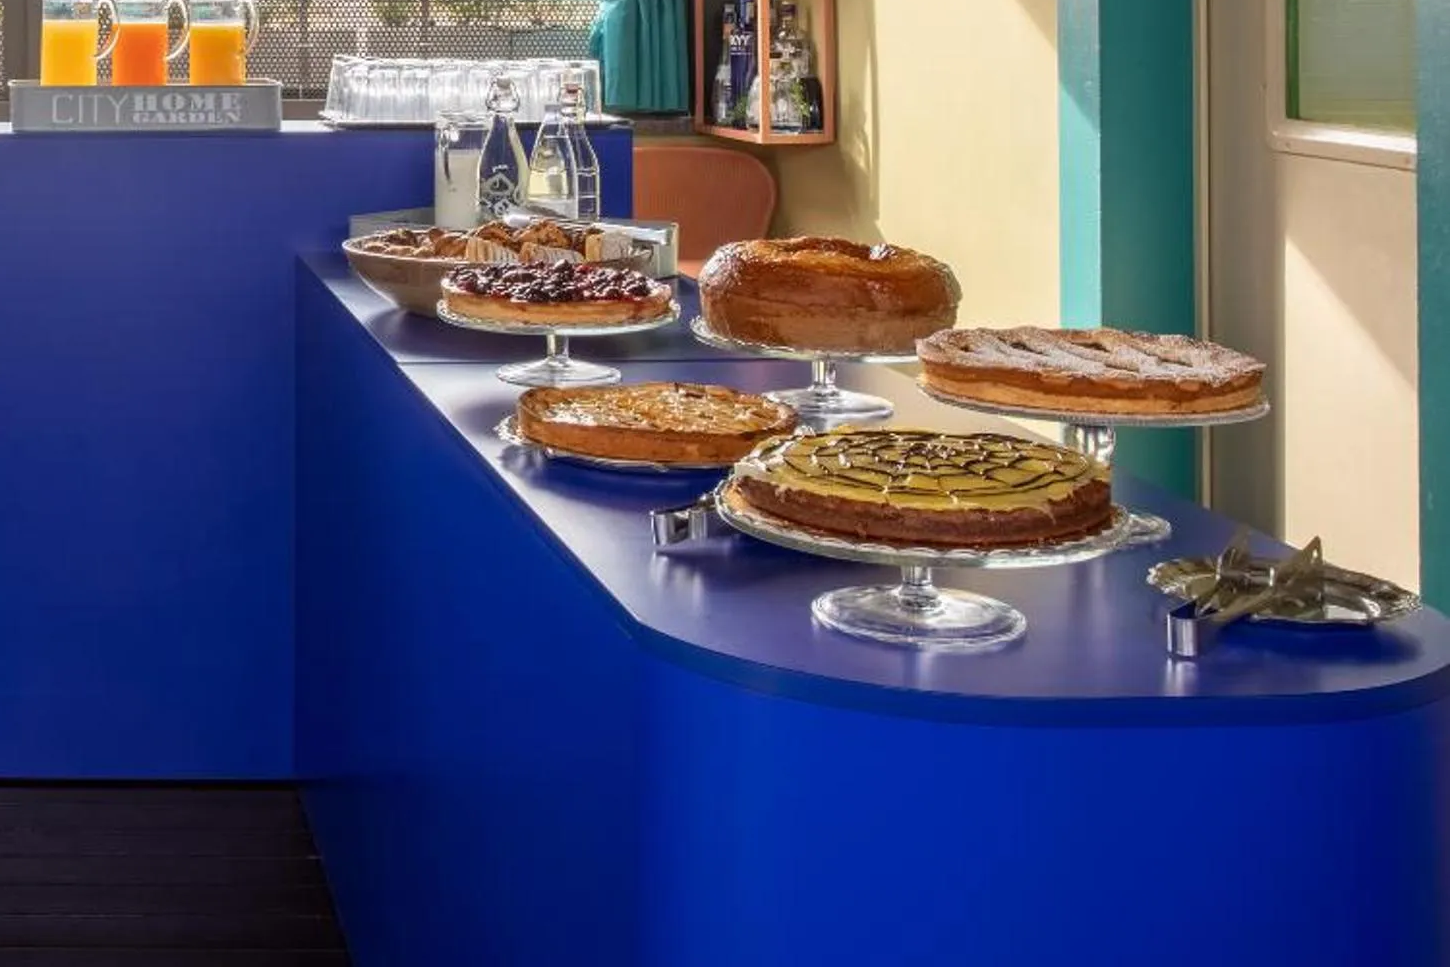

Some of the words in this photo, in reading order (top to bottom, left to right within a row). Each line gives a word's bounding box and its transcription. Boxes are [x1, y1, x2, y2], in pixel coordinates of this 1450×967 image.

[52, 93, 129, 124] CITY
[133, 92, 242, 111] HOME
[133, 111, 242, 124] GARDEN
